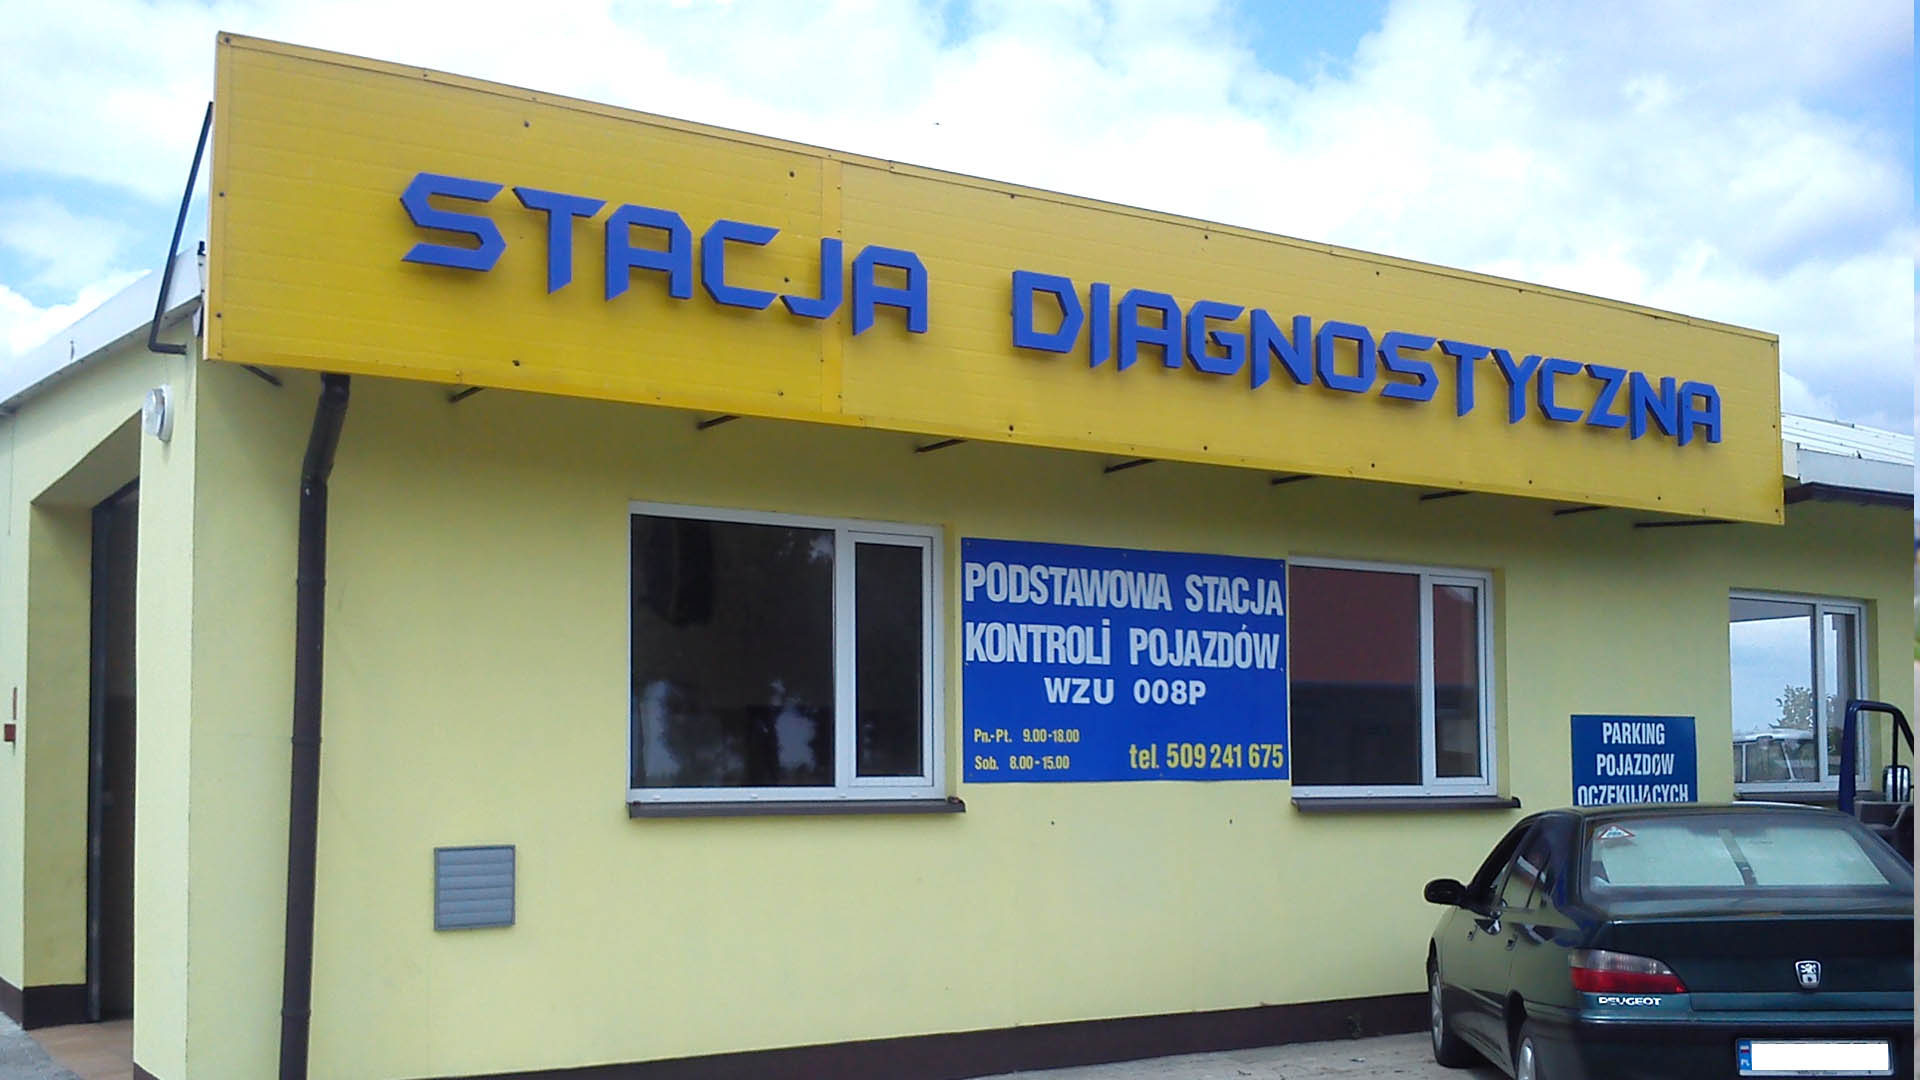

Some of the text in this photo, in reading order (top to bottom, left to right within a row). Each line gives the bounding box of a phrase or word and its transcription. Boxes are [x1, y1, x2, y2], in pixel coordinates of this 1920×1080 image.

[400, 171, 1721, 447] STACJA DIAGNOSTYCZNA
[964, 562, 1284, 616] PODSTAWOWA STACJA
[1129, 624, 1280, 670] POJAZDÓW
[1044, 677, 1207, 705] WZU 008P
[1602, 722, 1665, 745] PARKING
[974, 755, 999, 770] Sob.
[1129, 743, 1284, 769] tel. 509 241 675
[1598, 996, 1662, 1006] PEUGEOT
